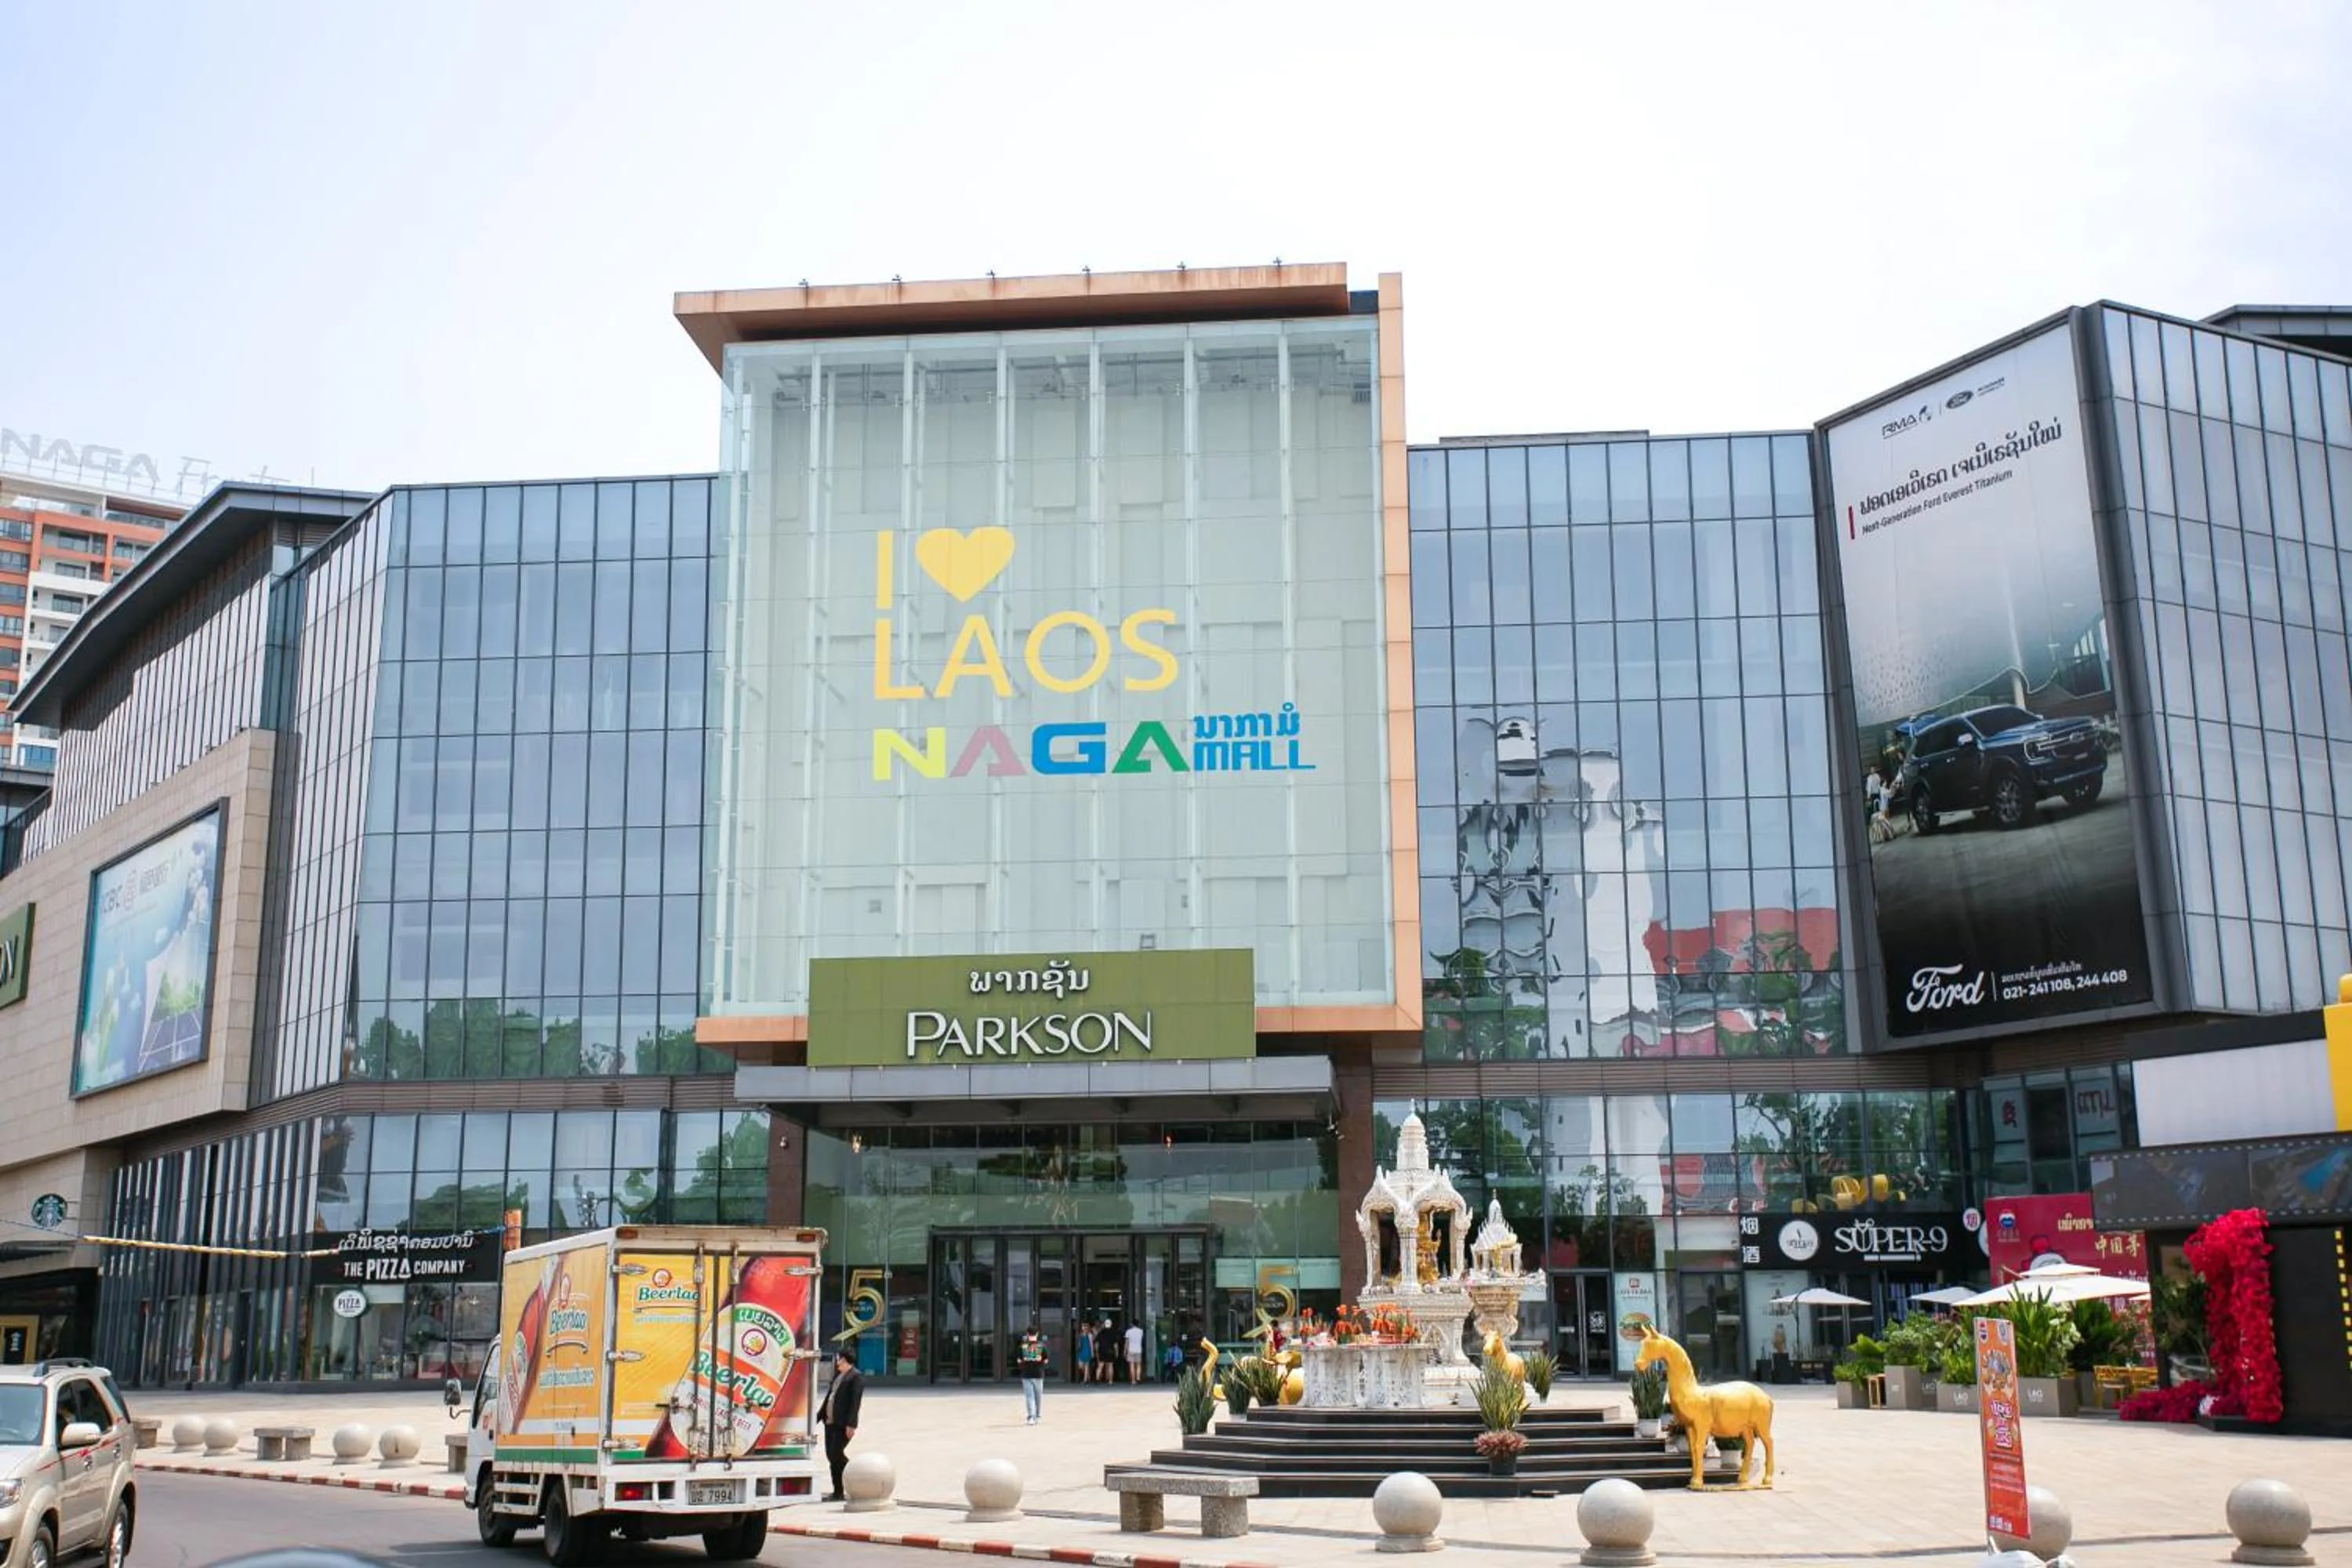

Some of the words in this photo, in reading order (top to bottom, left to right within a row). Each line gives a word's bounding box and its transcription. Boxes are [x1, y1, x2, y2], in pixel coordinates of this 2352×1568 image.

[1882, 415, 1918, 437] RMA
[1, 427, 161, 482] NAGA
[1923, 495, 1942, 510] Ford
[1943, 483, 1973, 503] Everest
[1974, 470, 2013, 490] Titanium
[876, 530, 893, 609] I
[873, 608, 1178, 700] LAOS
[873, 720, 1191, 781] NAGA
[1193, 739, 1316, 771] MALL
[1906, 964, 1984, 1013] Ford
[2077, 973, 2100, 989] 244
[2103, 969, 2129, 984] 408
[907, 1011, 1152, 1057] PARKSON
[1834, 1218, 1948, 1254] SUPER-9
[343, 1261, 363, 1277] THE
[365, 1258, 412, 1280] PIZZA
[413, 1259, 465, 1275] COMPANY
[338, 1298, 361, 1308] PIZZA
